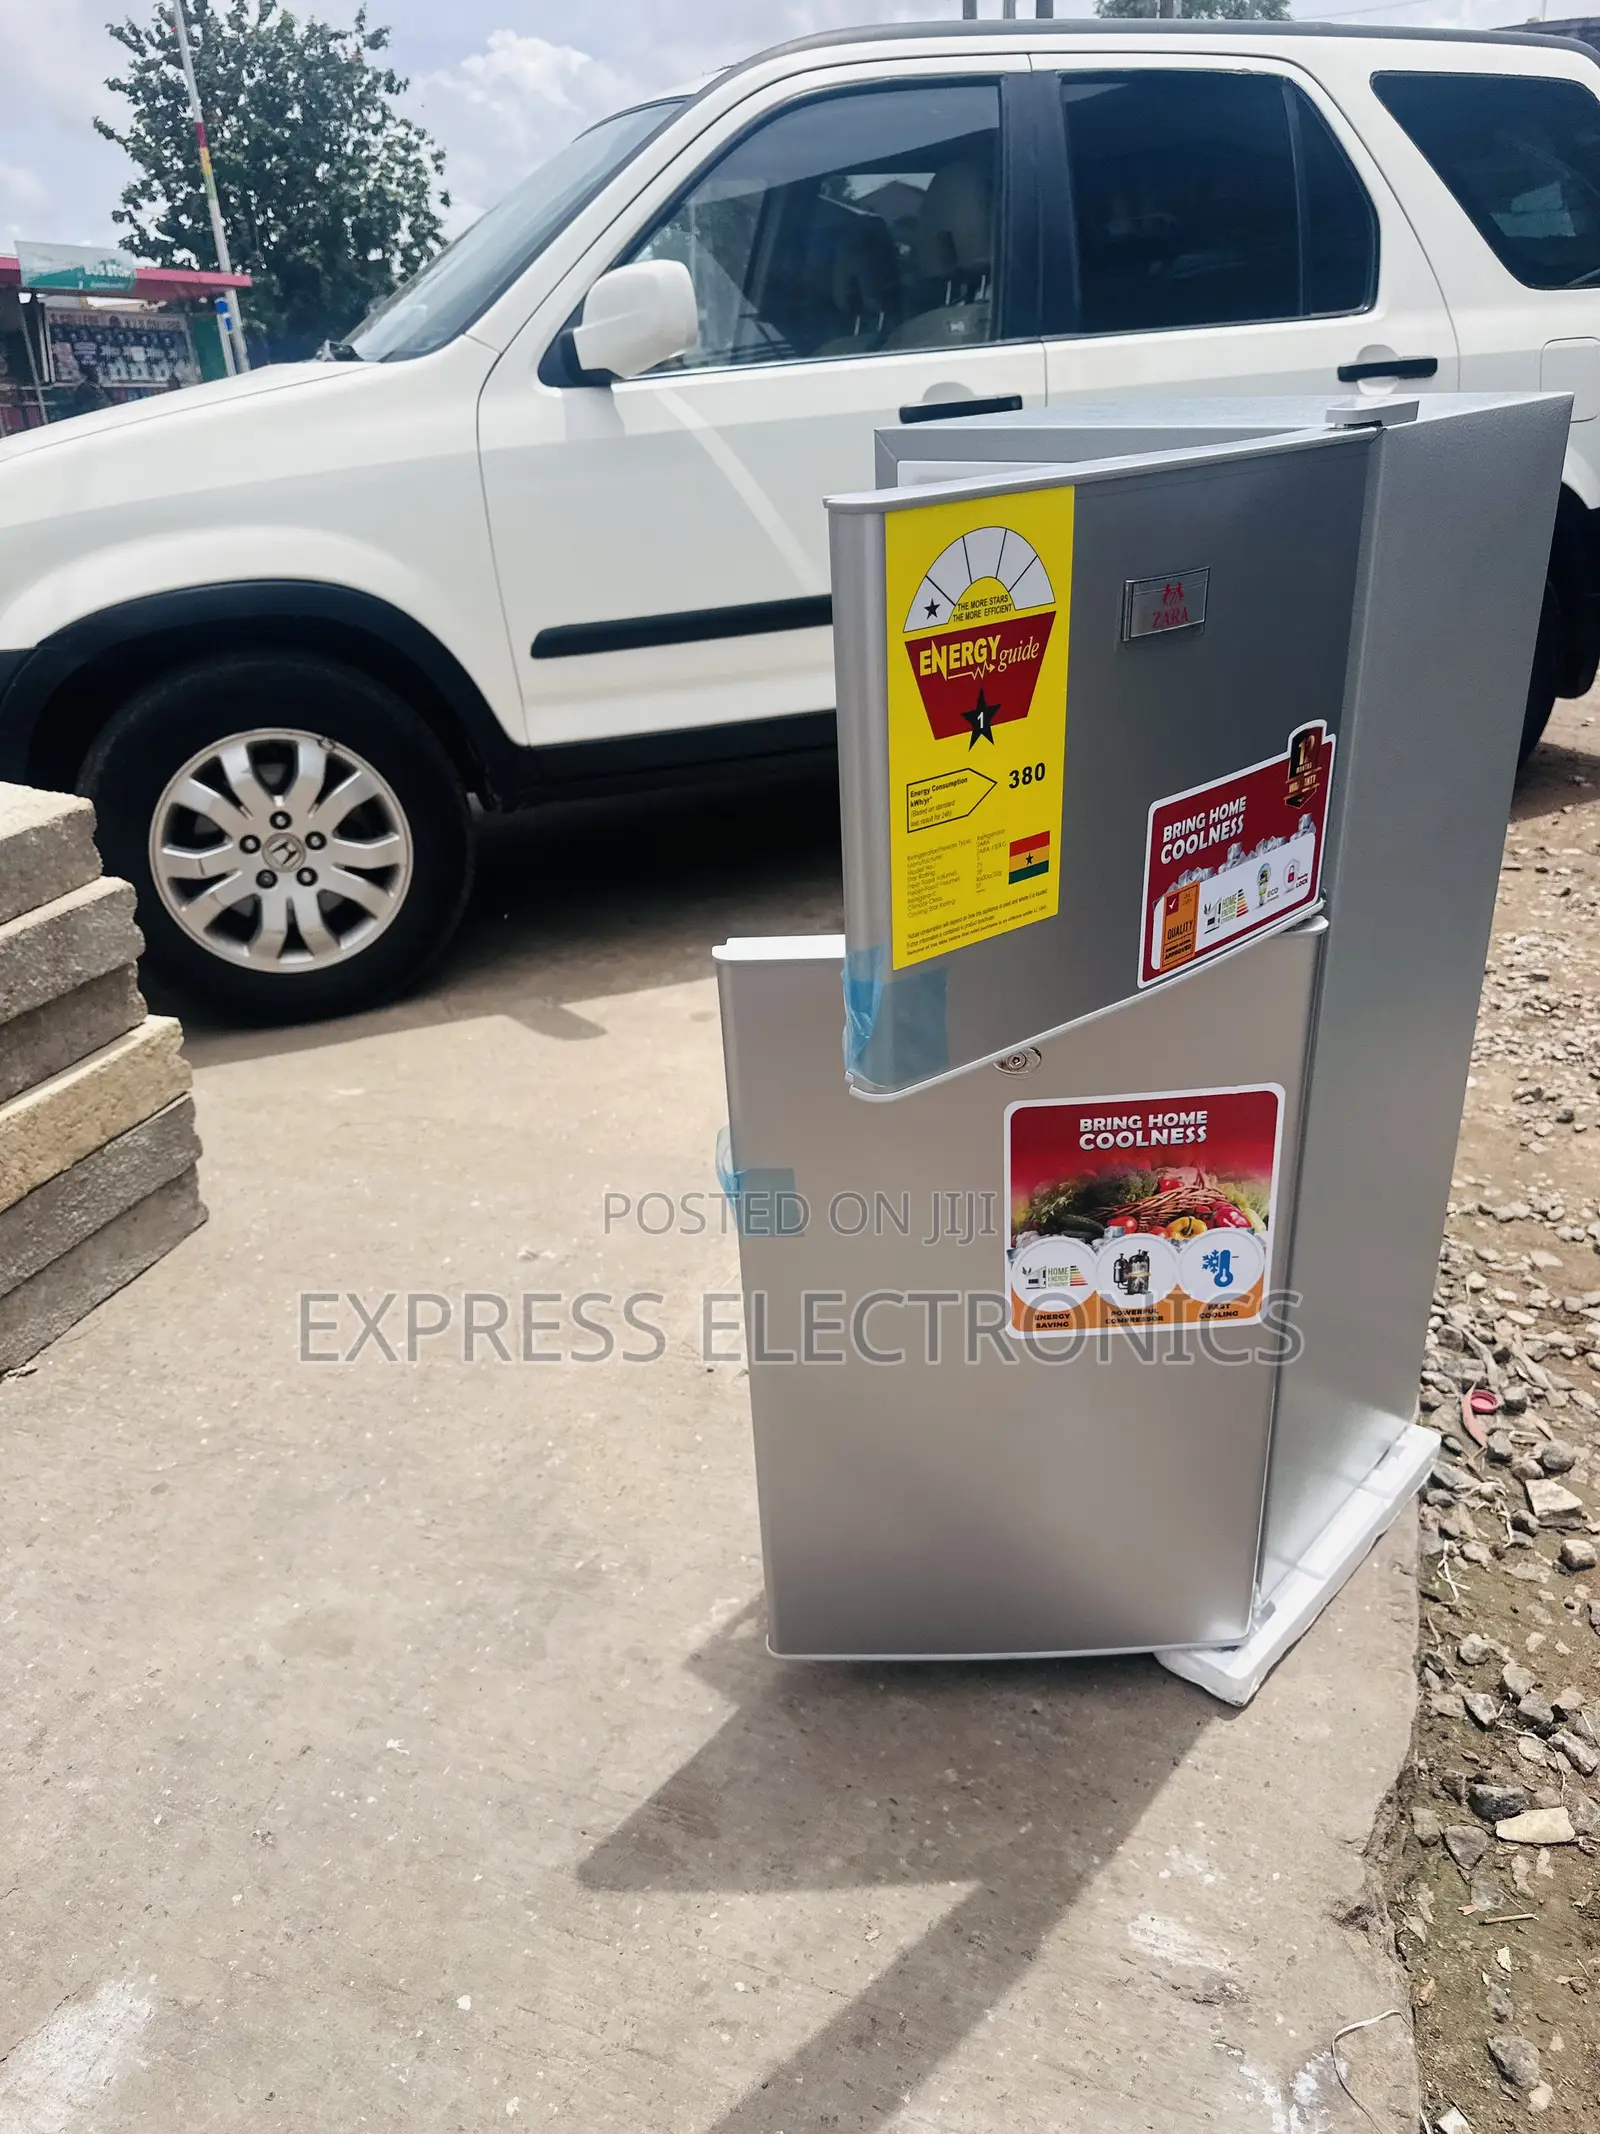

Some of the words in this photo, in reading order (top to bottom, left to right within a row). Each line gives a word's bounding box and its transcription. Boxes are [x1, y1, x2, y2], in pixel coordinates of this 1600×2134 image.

[953, 611, 964, 622] THE
[964, 609, 982, 621] MORE
[984, 602, 1012, 617] EFFICIENT
[957, 601, 969, 612] THE
[971, 598, 988, 609] MORE
[989, 594, 1009, 606] STARS
[1152, 606, 1189, 629] ZARA
[919, 634, 1001, 682] ENERGY
[998, 636, 1040, 672] guide
[977, 711, 984, 729] 1
[1008, 761, 1046, 789] 380
[910, 787, 930, 798] Energy
[932, 777, 968, 792] Consumption
[1162, 811, 1206, 844] BRING
[1209, 795, 1247, 825] HOME
[1160, 814, 1245, 866] COOLNESS
[1267, 887, 1279, 899] ECO
[1167, 919, 1194, 941] QUALITY
[1079, 1115, 1142, 1133] BRING
[1148, 1110, 1208, 1128] HOME
[1079, 1125, 1208, 1151] COOLNESS
[1034, 1313, 1070, 1322] ENERGY
[1105, 1316, 1164, 1325] COMPRESSOR
[1111, 1308, 1160, 1317] POWERFUL
[1199, 1309, 1239, 1319] COOLING
[1035, 1321, 1069, 1329] SAVING
